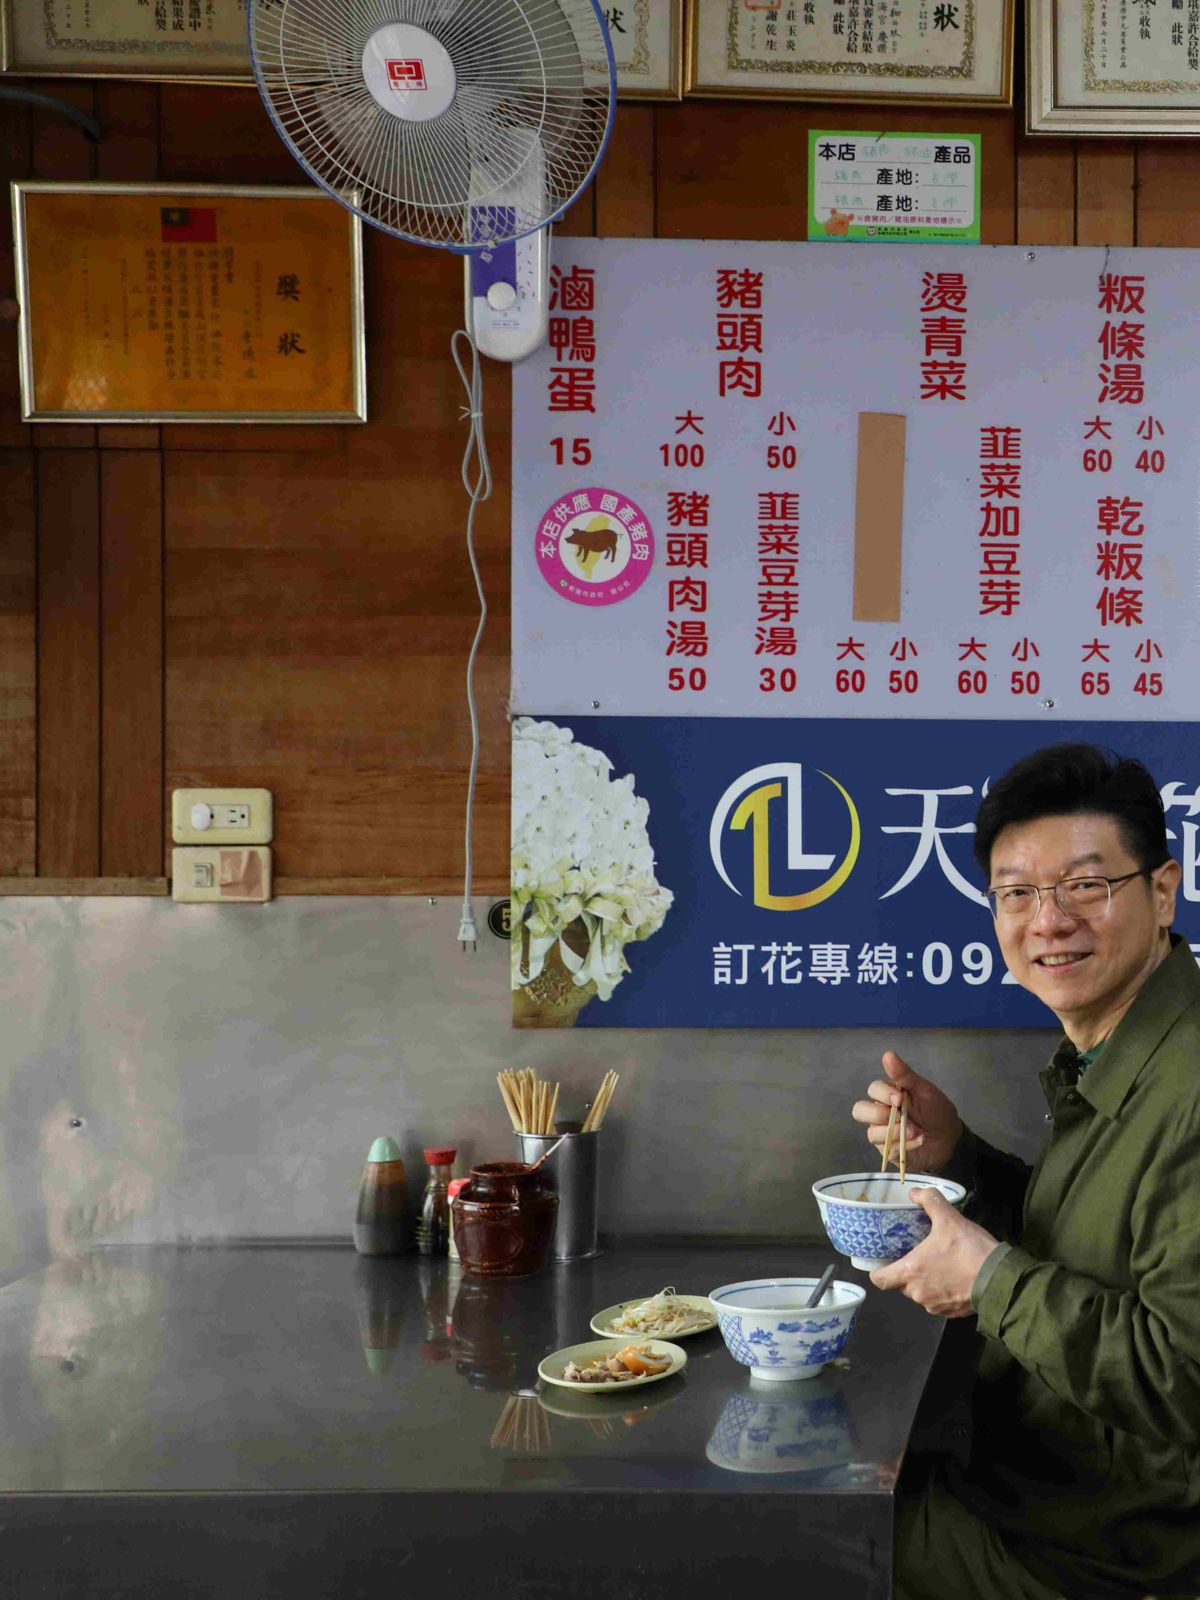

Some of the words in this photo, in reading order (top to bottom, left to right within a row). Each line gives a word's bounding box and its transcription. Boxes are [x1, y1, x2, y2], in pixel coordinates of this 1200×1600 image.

[933, 4, 959, 31] 狀
[1139, 15, 1151, 40] 收執
[818, 142, 856, 161] 本店
[933, 145, 971, 164] 產品
[548, 264, 597, 414] 滷鴨蛋
[716, 267, 763, 398] 豬頭肉
[920, 271, 968, 400] 燙青菜
[1097, 272, 1146, 405] 粄條湯
[675, 410, 704, 435] 大
[767, 411, 796, 436] 小
[1083, 415, 1112, 440] 大
[1136, 415, 1165, 440] 小
[549, 437, 592, 466] 15
[659, 443, 705, 468] 100
[767, 445, 797, 469] 50
[1083, 449, 1112, 473] 60
[1135, 449, 1165, 473] 40
[540, 492, 592, 559] 本店供應
[600, 493, 650, 561] 國產豬肉
[665, 490, 710, 657] 豬頭肉湯
[1096, 495, 1145, 627] 乾粄條
[836, 636, 865, 661] 大
[889, 636, 918, 661] 小
[958, 636, 987, 662] 大
[1011, 637, 1040, 662] 小
[1081, 638, 1110, 663] 大
[1134, 638, 1163, 663] 小
[668, 667, 707, 691] 50
[759, 667, 797, 692] 30
[835, 669, 866, 693] 60
[888, 669, 919, 694] 50
[957, 670, 988, 694] 60
[1010, 670, 1041, 695] 50
[1080, 672, 1111, 696] 65
[1133, 672, 1163, 697] 45
